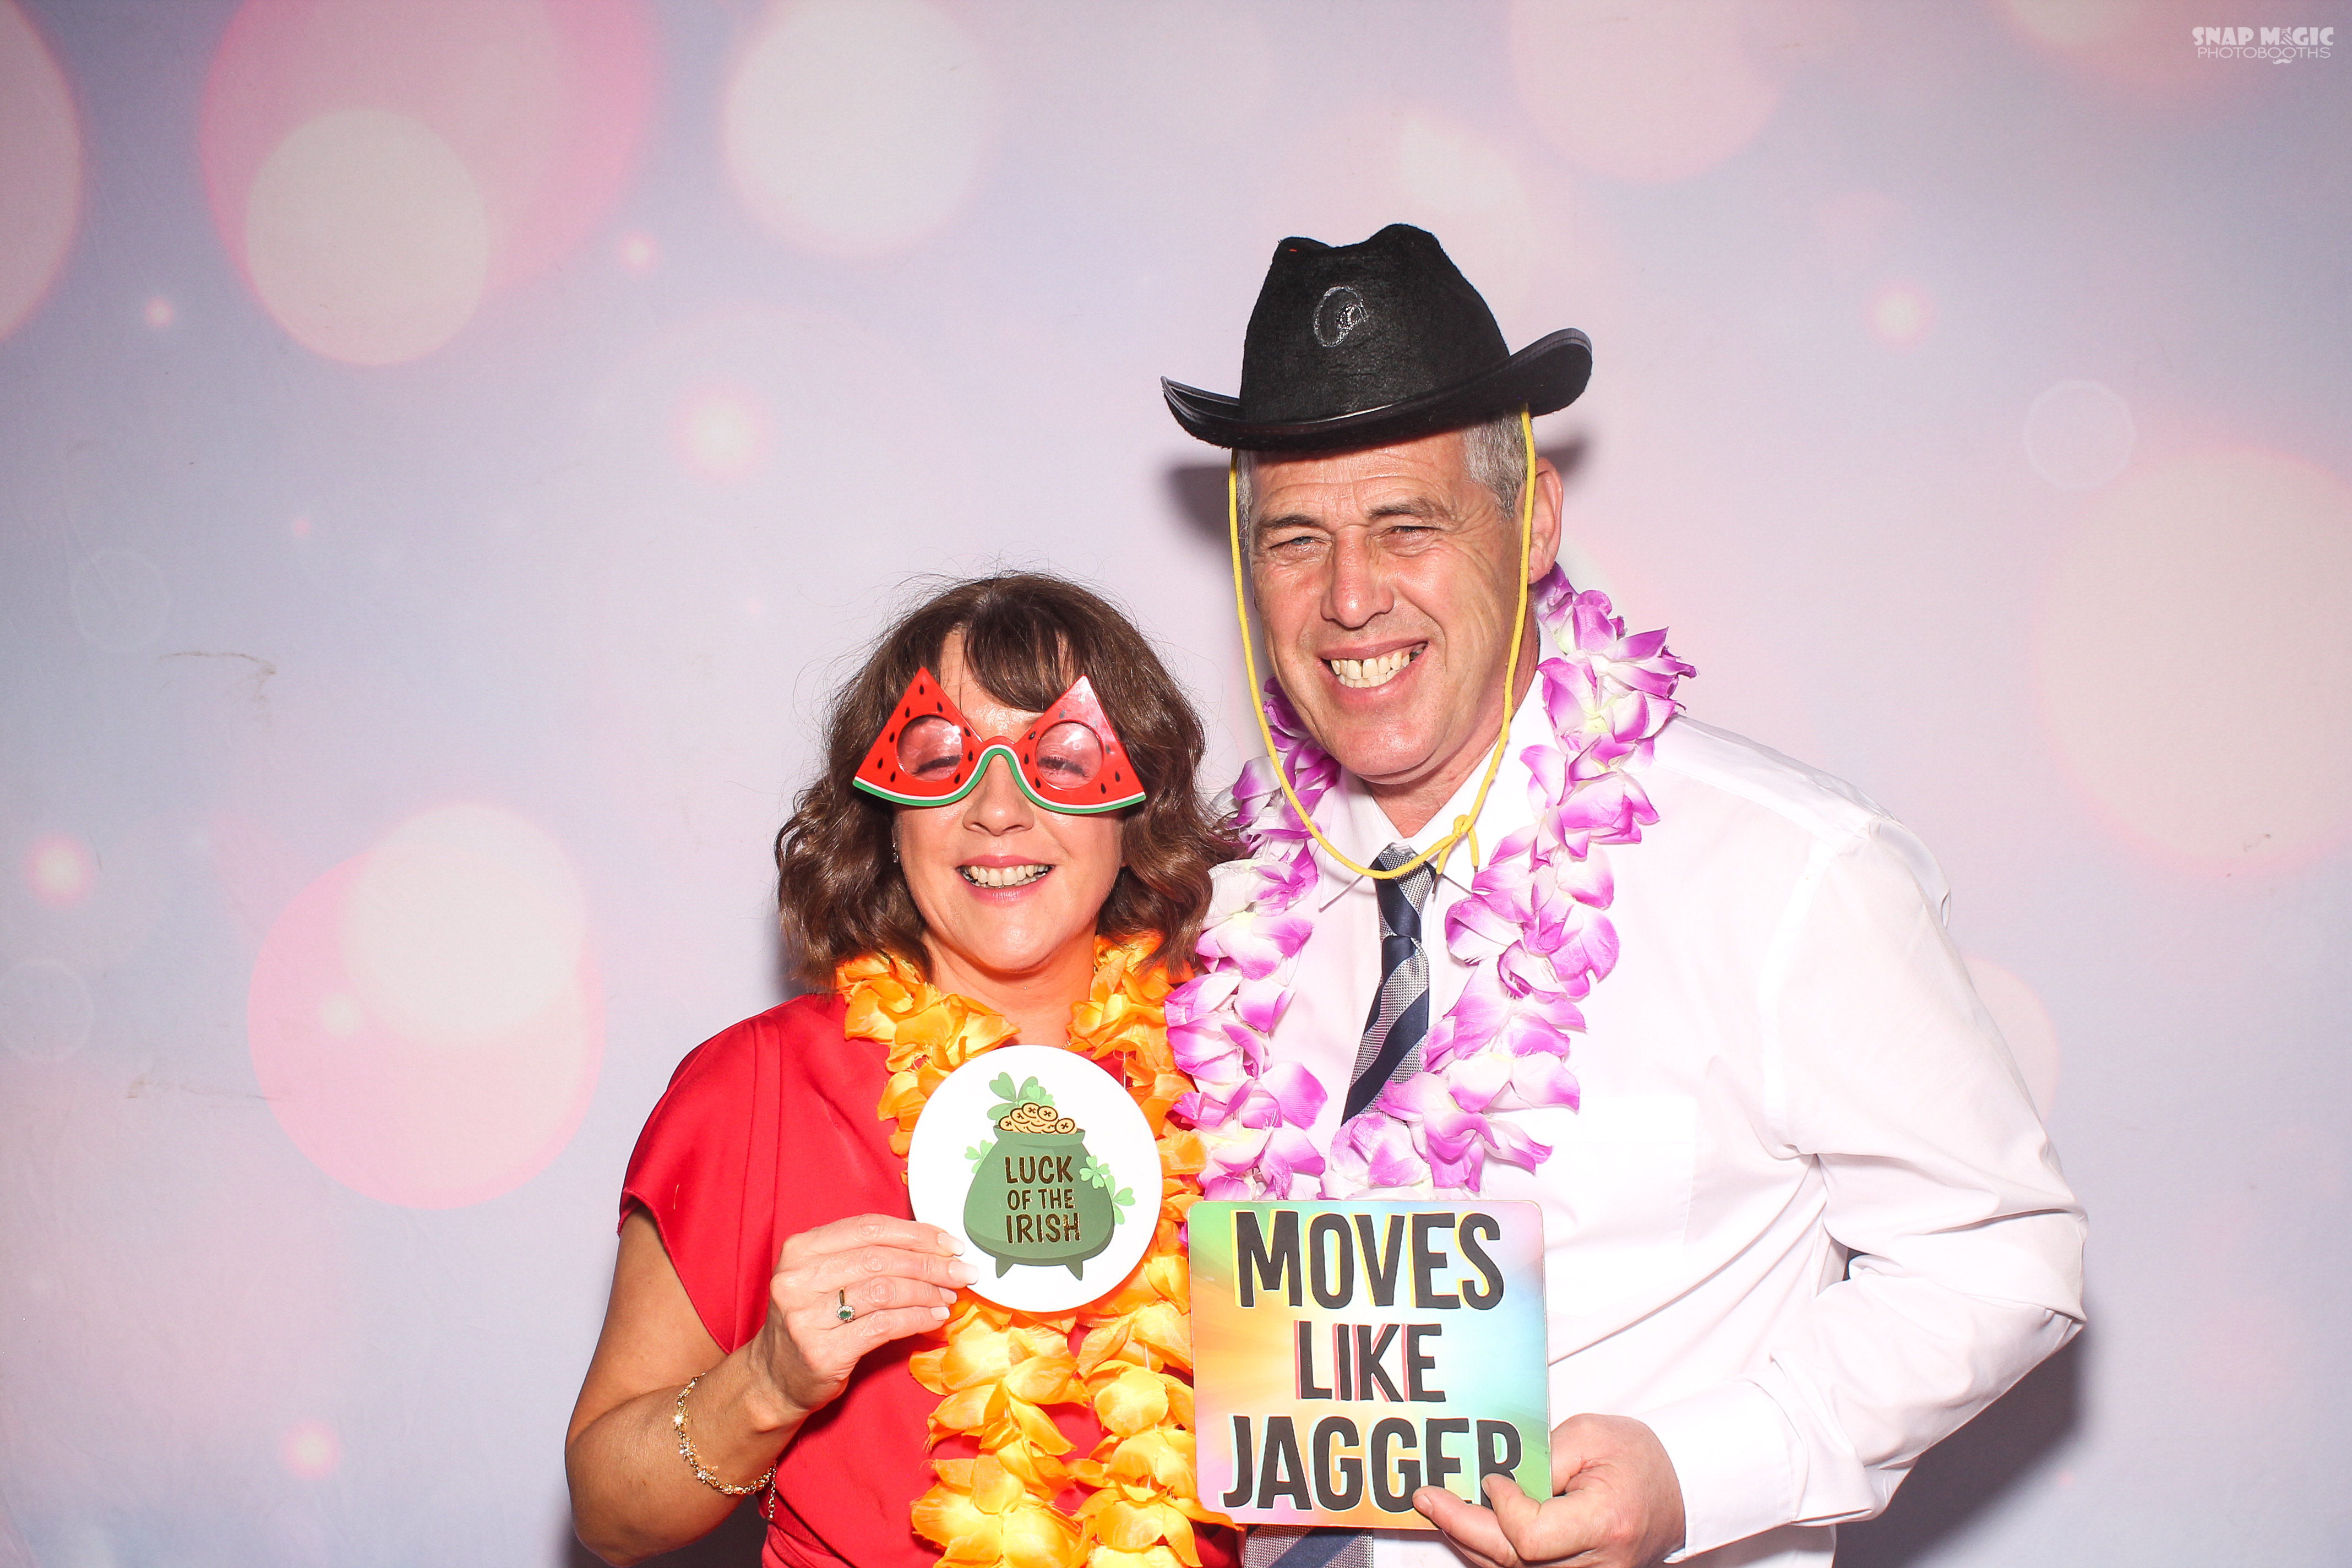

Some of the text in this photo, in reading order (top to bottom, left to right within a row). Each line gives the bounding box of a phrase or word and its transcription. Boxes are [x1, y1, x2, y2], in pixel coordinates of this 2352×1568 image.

[1005, 1155, 1074, 1184] LUCK
[1007, 1188, 1076, 1210] OF THE
[1005, 1212, 1081, 1244] IRISH
[1231, 1210, 1504, 1310] MOVES
[1294, 1320, 1446, 1402] LIKE
[1219, 1415, 1522, 1512] JAGGER
